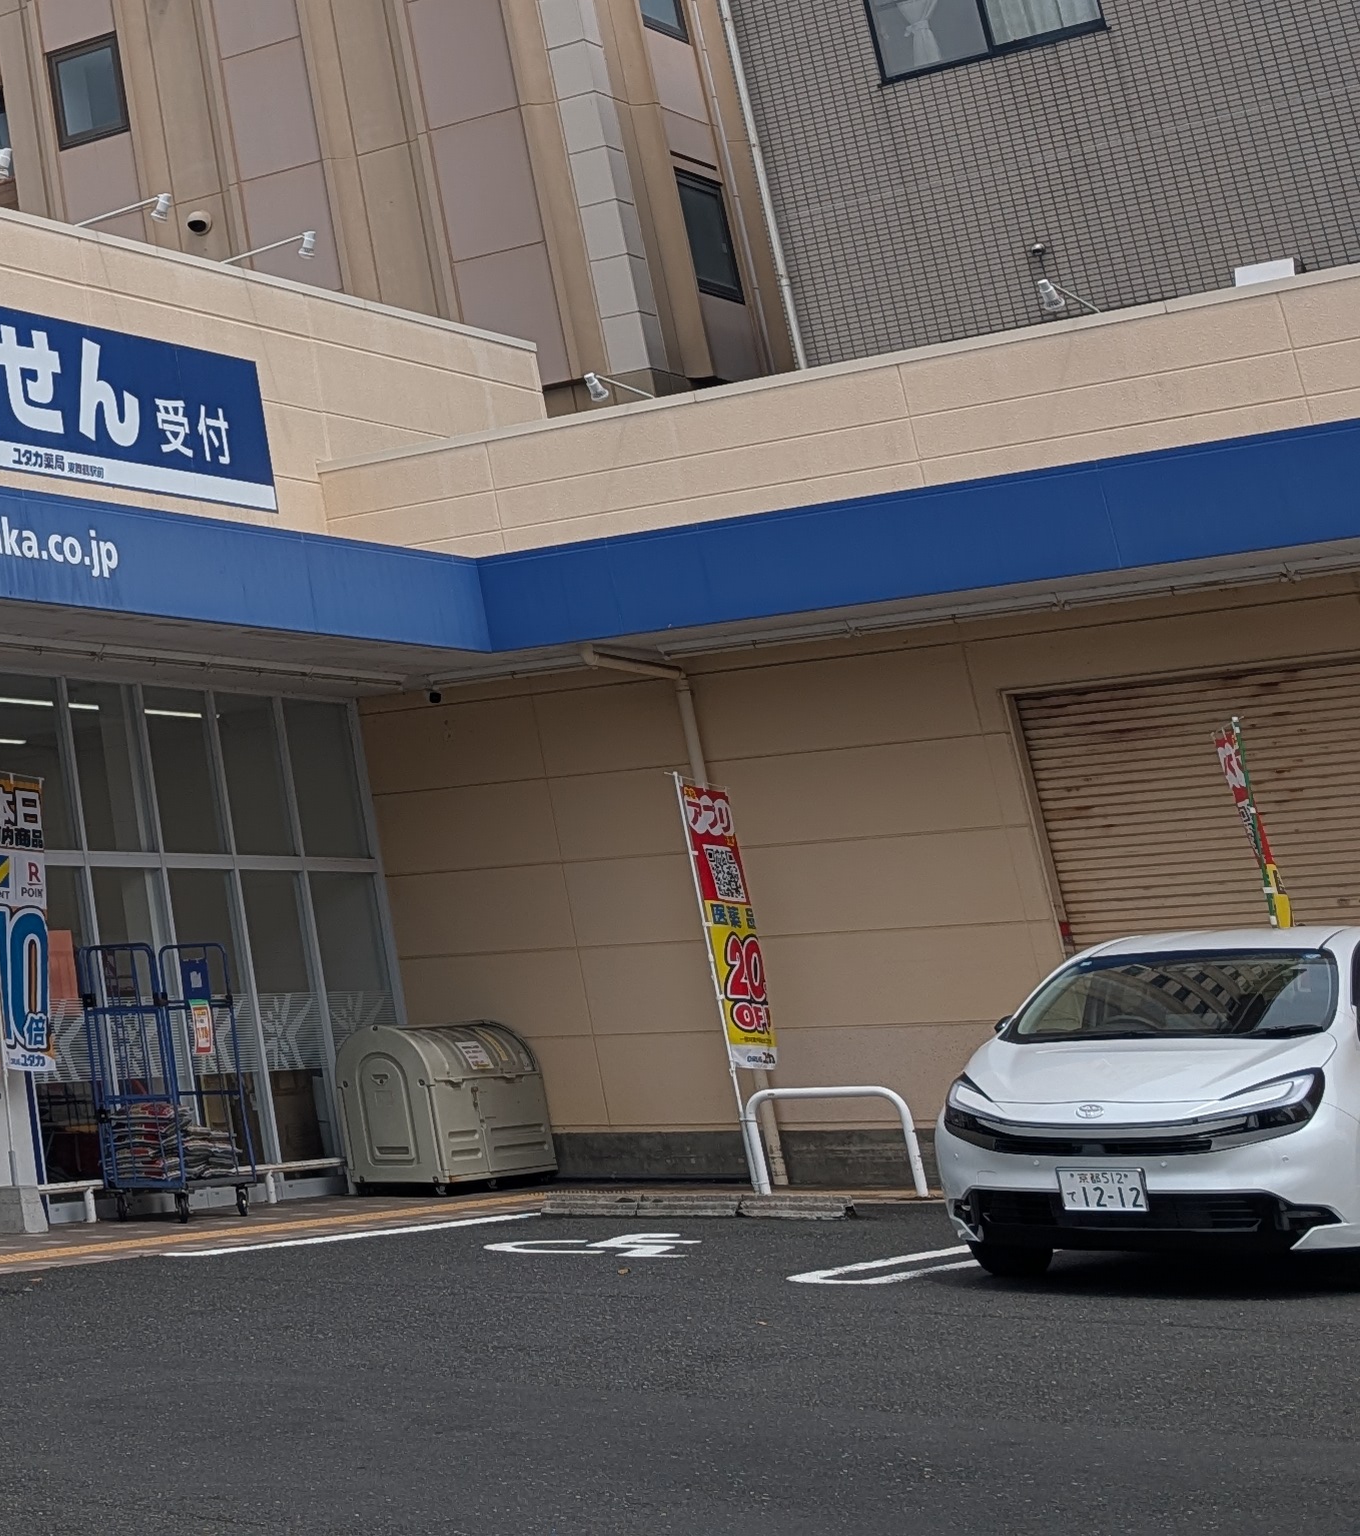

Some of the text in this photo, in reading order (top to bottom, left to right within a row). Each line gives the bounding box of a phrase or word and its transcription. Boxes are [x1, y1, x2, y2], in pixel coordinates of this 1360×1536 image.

[155, 397, 230, 465] 受付
[12, 448, 65, 471] ユタカ薬局
[27, 861, 41, 883] R
[21, 886, 44, 898] POIN
[727, 934, 768, 1002] 20
[21, 1054, 46, 1066] ユタカ
[1081, 1186, 1145, 1208] 12-12
